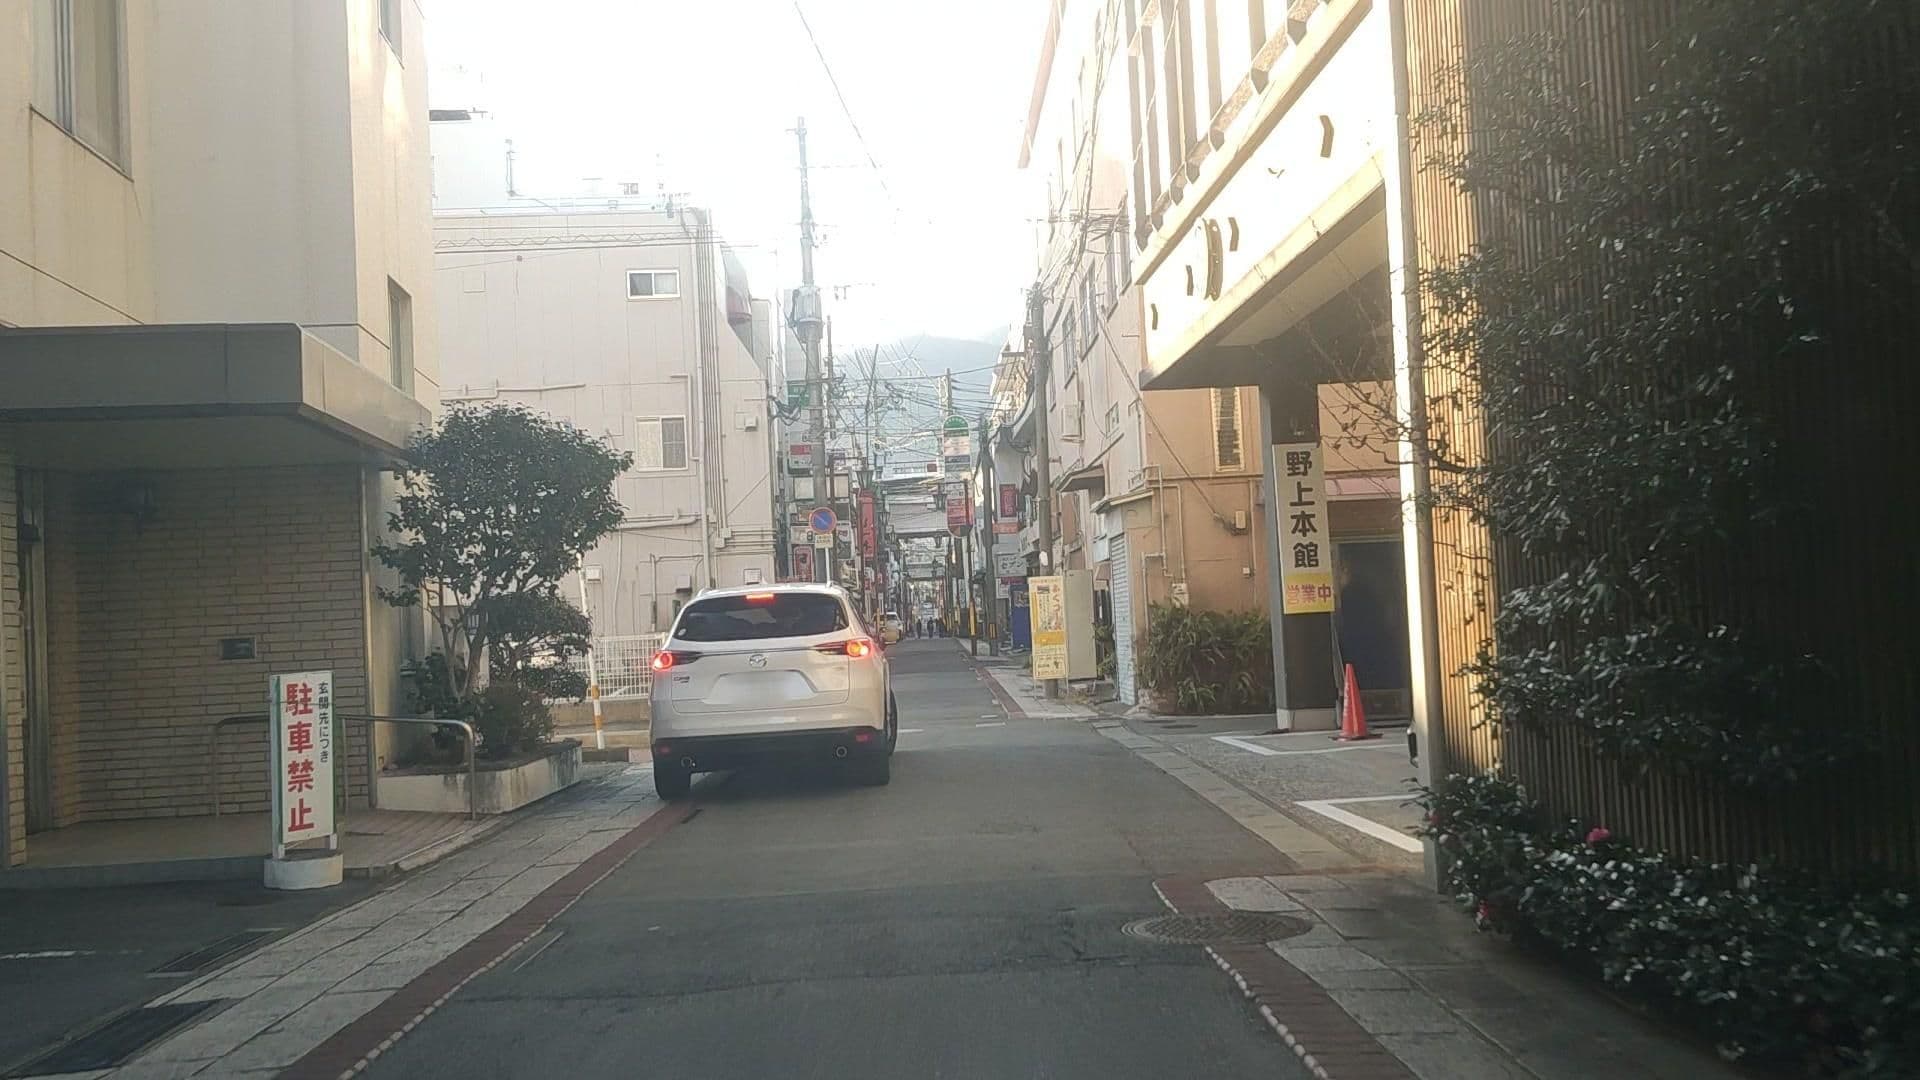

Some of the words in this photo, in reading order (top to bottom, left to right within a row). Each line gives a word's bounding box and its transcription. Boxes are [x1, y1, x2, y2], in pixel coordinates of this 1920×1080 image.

[1286, 451, 1319, 568] 野上本館
[1287, 584, 1331, 605] 営業中
[285, 682, 315, 832] 駐車禁止
[318, 682, 329, 763] 玄関先につき
